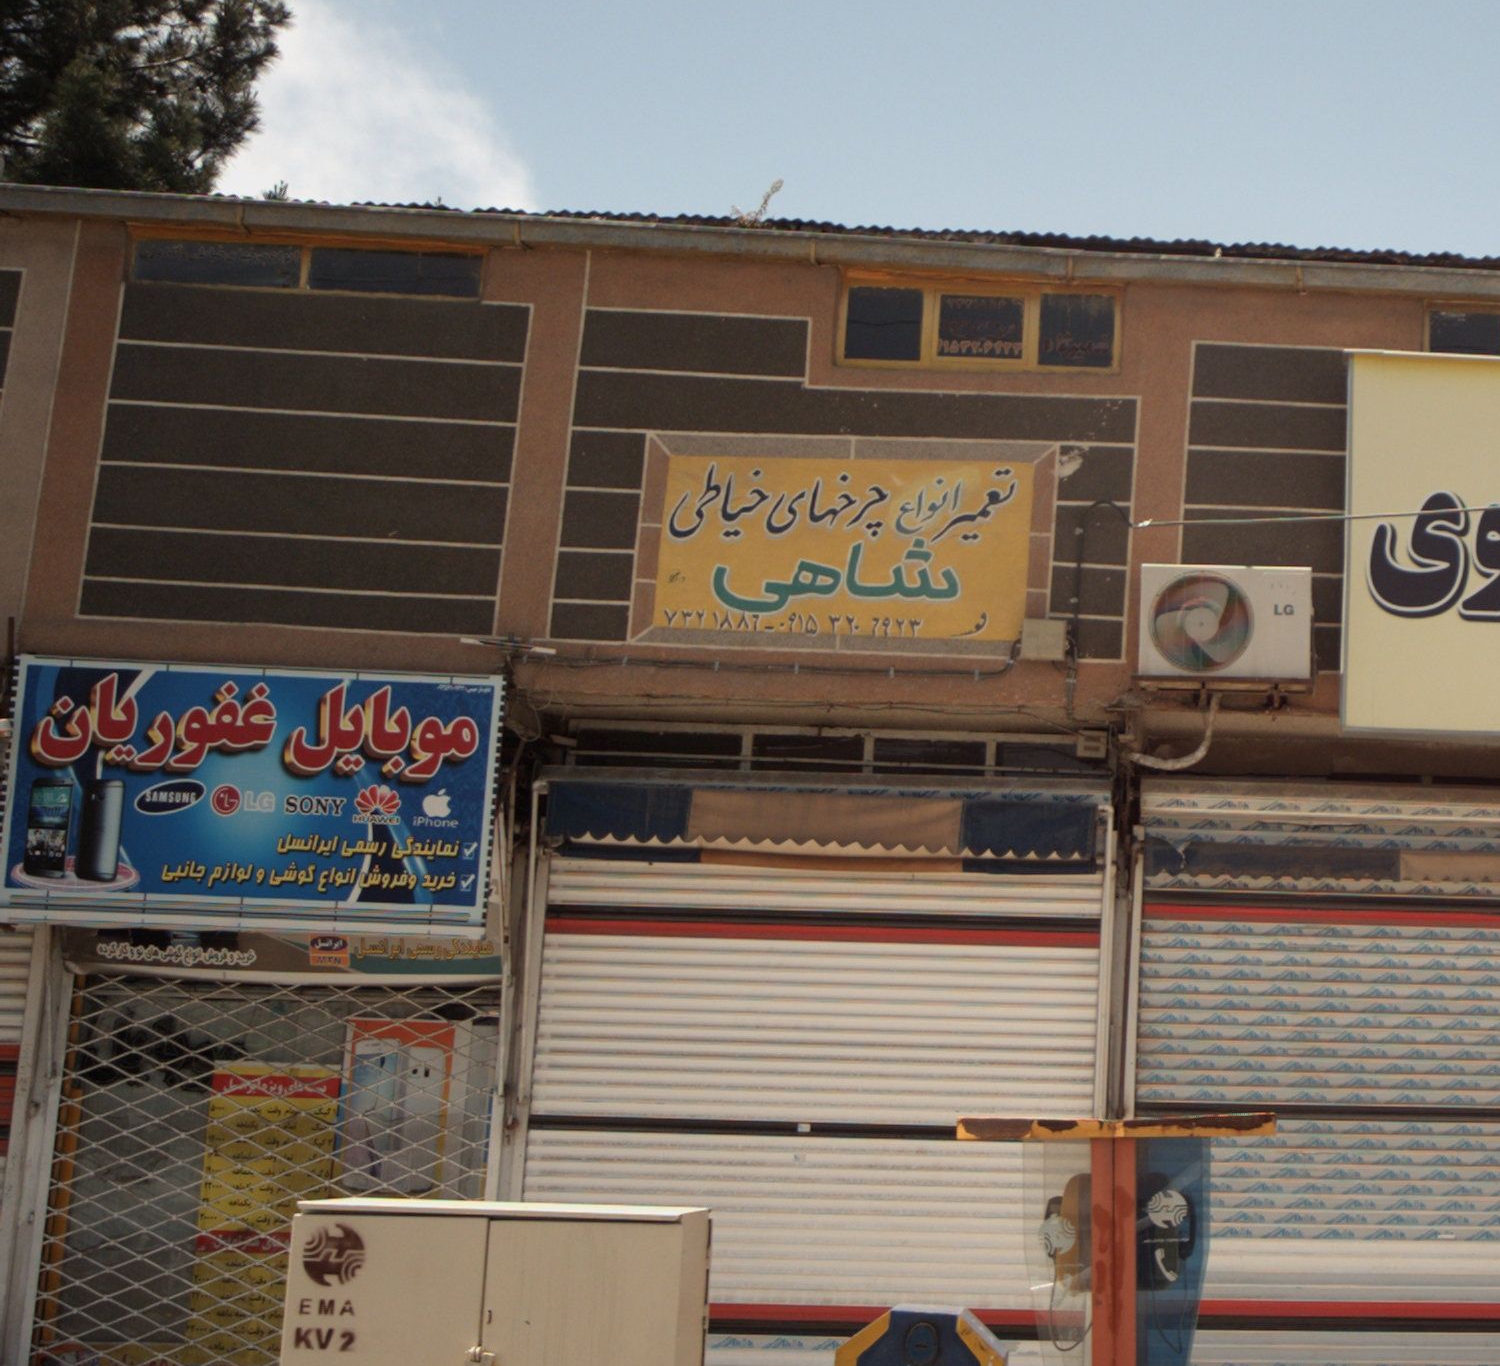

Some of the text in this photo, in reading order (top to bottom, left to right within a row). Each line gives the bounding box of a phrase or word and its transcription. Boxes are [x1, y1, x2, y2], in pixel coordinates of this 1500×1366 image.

[669, 462, 769, 539] خیاطی
[895, 477, 962, 534] انواع
[931, 467, 1017, 544] تعمیر
[712, 537, 960, 613] شاهی
[1273, 604, 1295, 616] LG
[31, 672, 480, 780] موبایل غفوریان
[144, 791, 197, 805] SAMSUNG
[243, 791, 275, 811] LG
[285, 796, 347, 816] SONY
[352, 815, 401, 825] HUAWEI
[412, 816, 459, 829] iPhone
[277, 834, 460, 860] نمایندگی رسمی ایرانسل
[161, 860, 206, 882] جانبی
[208, 863, 254, 888] لوازم
[269, 861, 317, 885] گوشی
[318, 867, 357, 891] انواع
[421, 872, 457, 891] خرید
